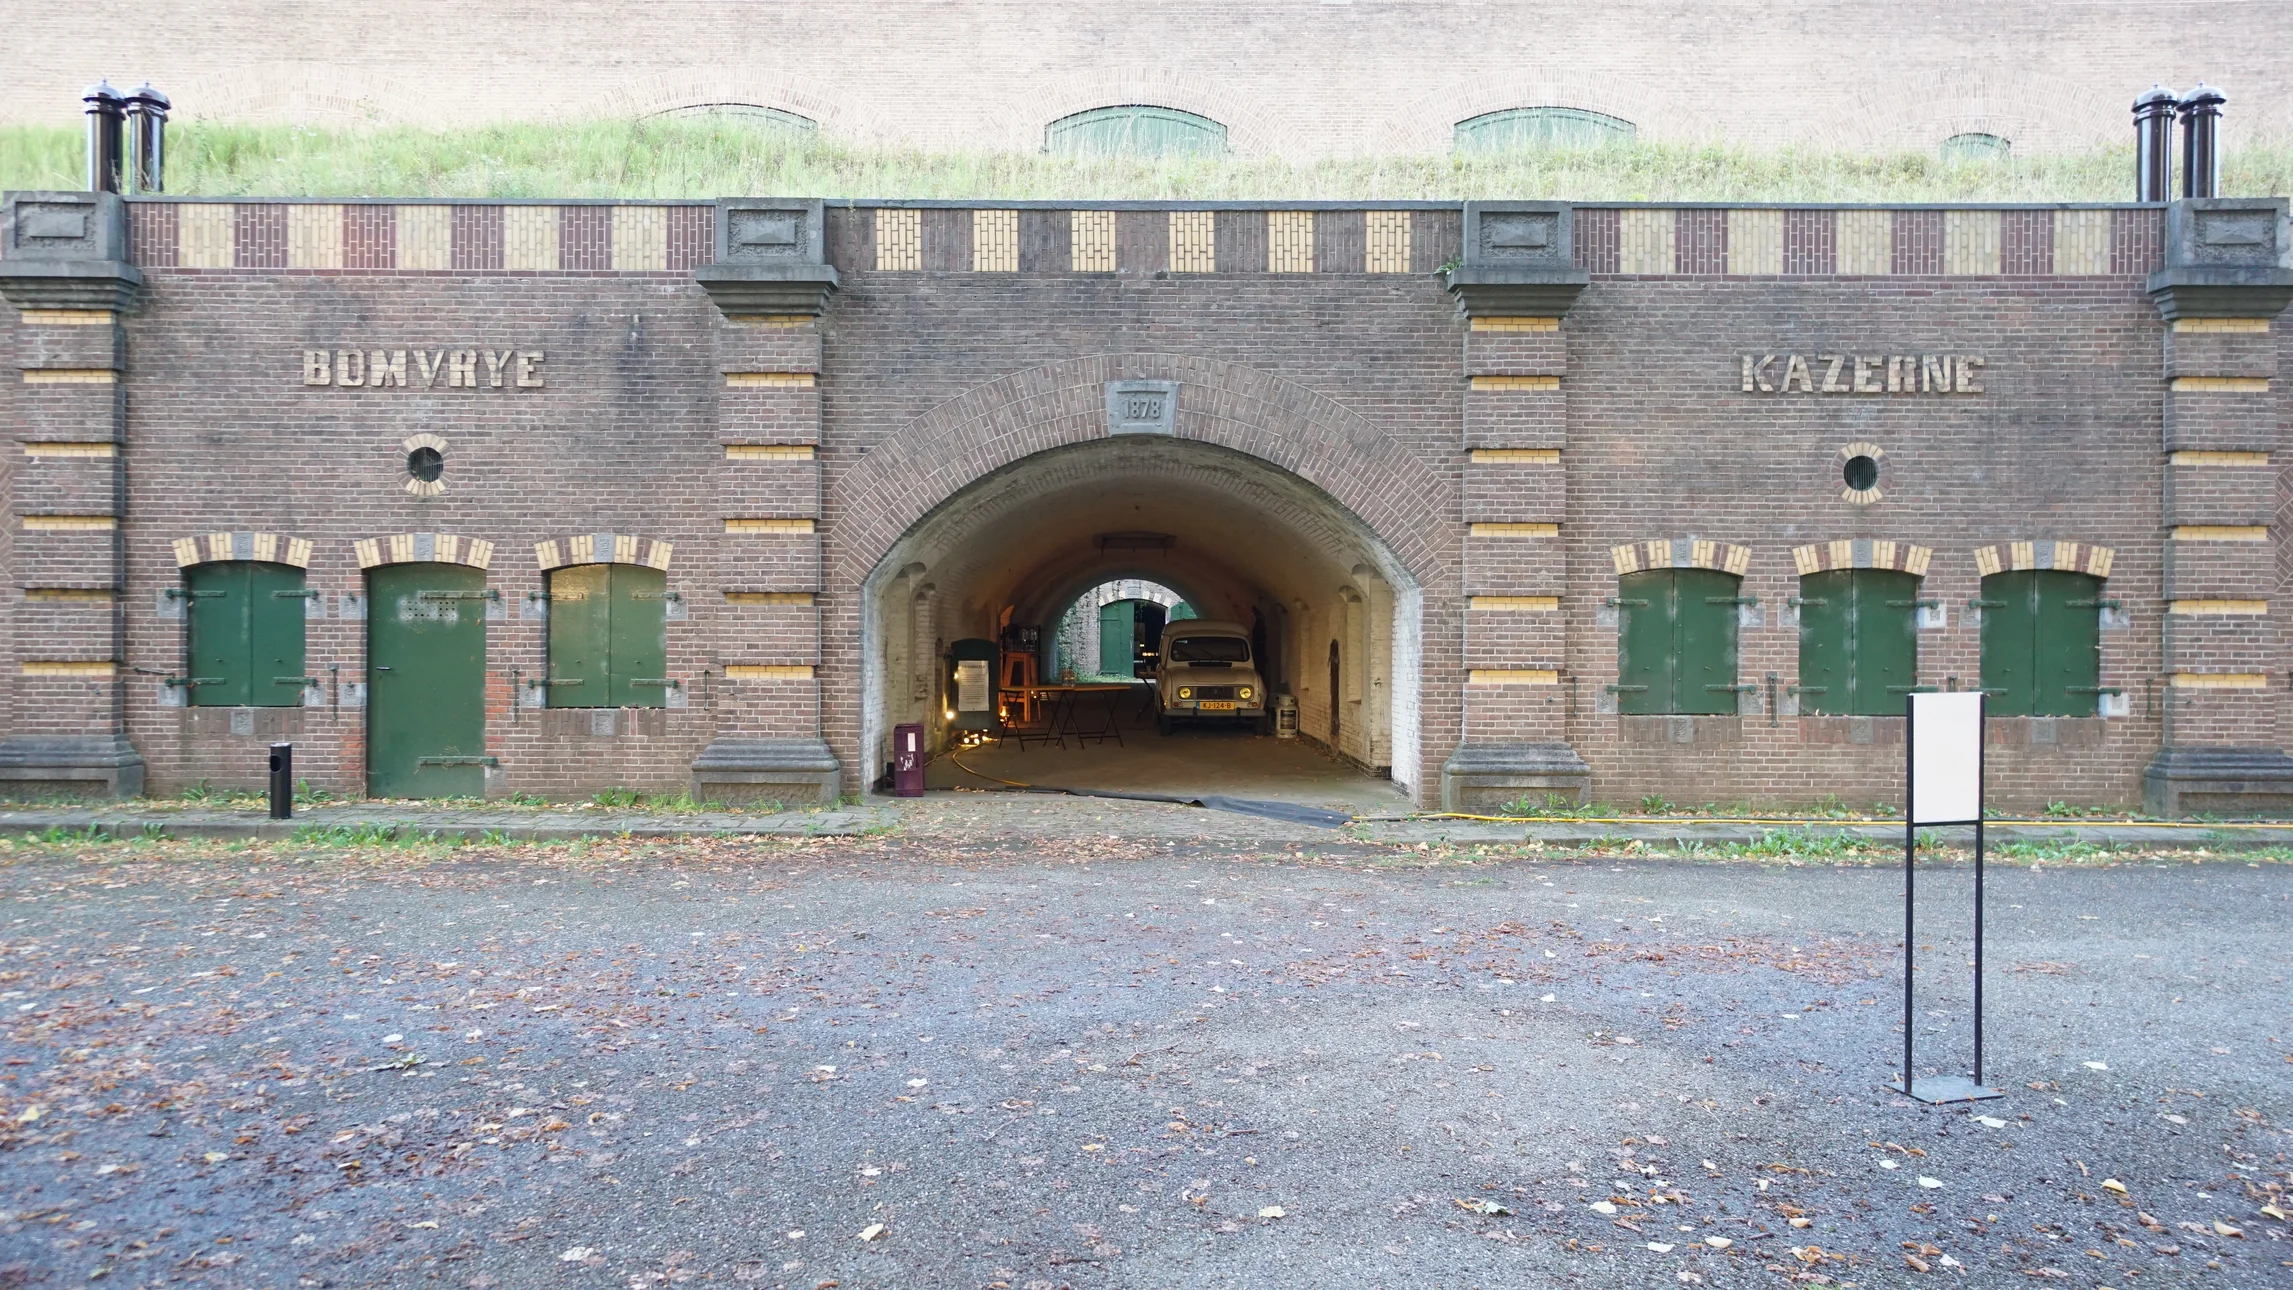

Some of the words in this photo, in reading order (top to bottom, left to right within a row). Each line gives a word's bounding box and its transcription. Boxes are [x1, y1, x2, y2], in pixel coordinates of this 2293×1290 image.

[303, 349, 545, 388] BOMVRYE
[1740, 353, 1985, 393] KAZERNE
[1121, 399, 1161, 419] 1878
